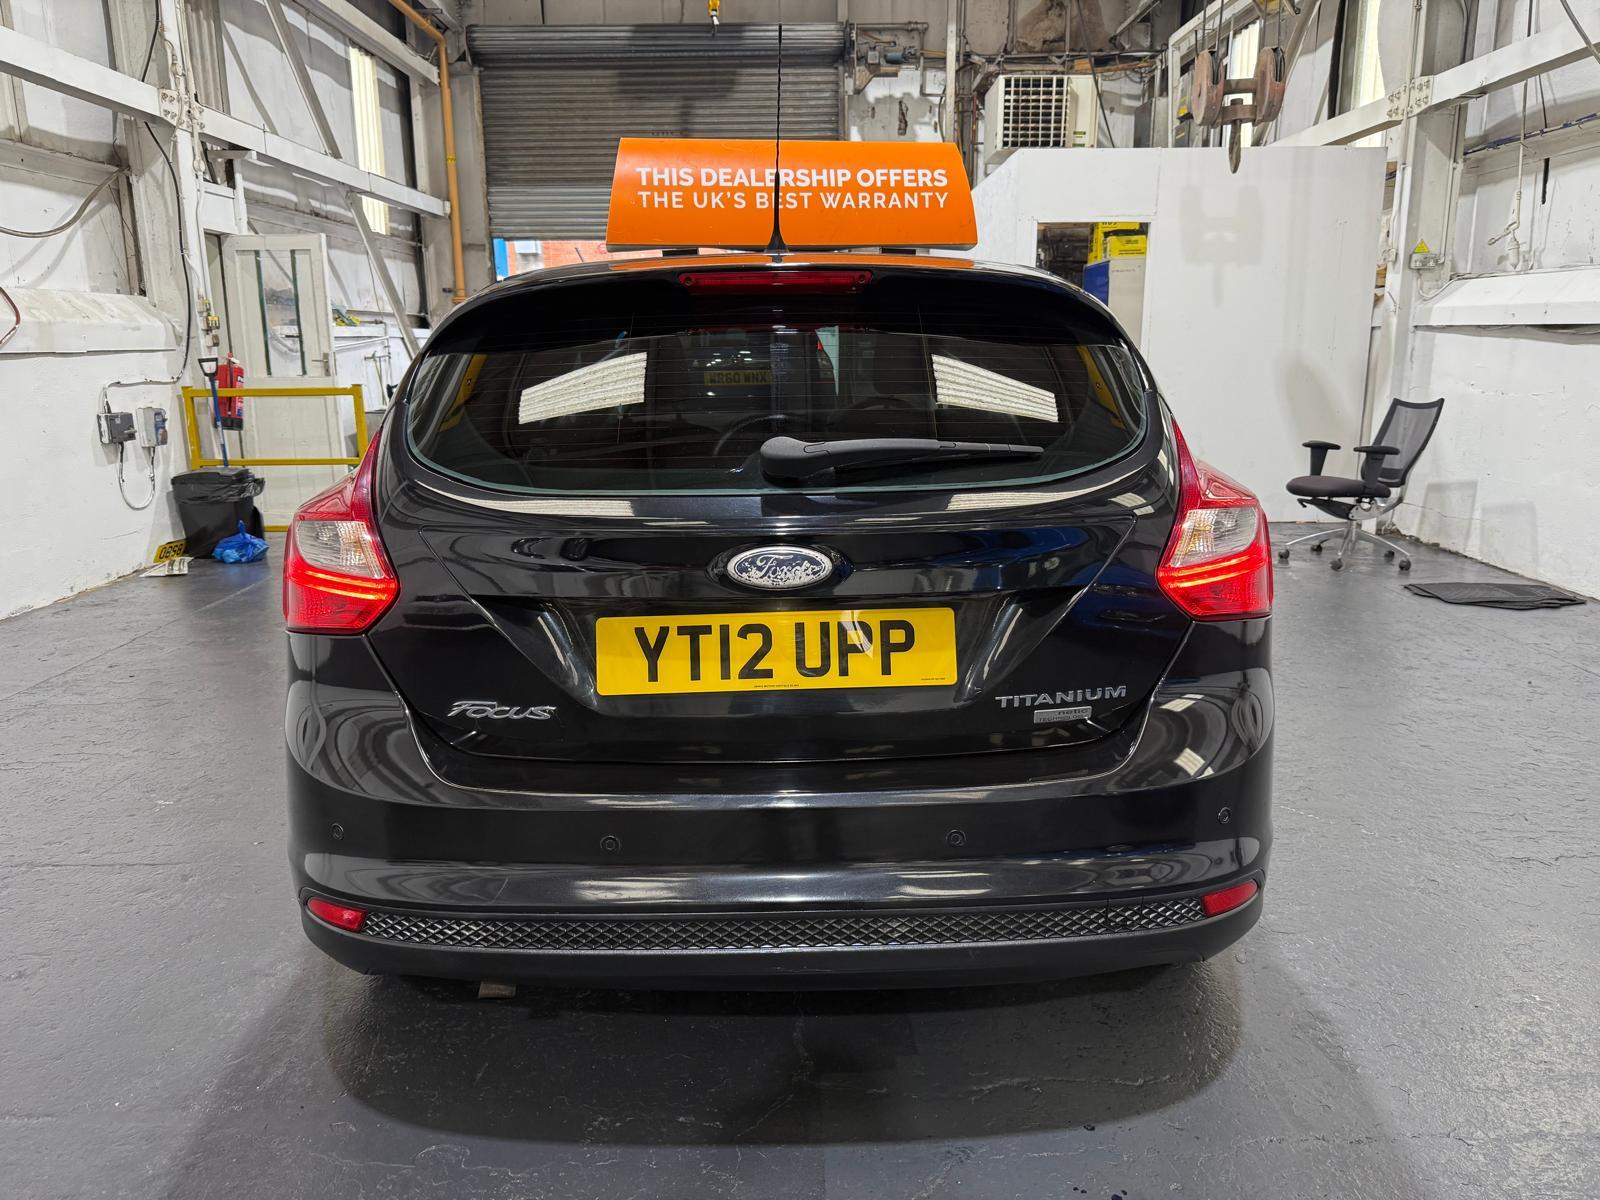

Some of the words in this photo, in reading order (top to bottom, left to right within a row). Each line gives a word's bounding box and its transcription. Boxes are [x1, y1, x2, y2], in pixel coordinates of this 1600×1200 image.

[635, 167, 695, 187] THIS
[701, 167, 851, 187] DEALERSHIP
[856, 168, 948, 188] OFFERS
[637, 191, 684, 208] THE
[693, 191, 746, 208] UK'S
[756, 191, 810, 209] BEST
[820, 191, 949, 209] WARRANTY
[756, 554, 822, 579] Ford
[634, 622, 774, 683] YT12
[795, 619, 916, 678] UPP
[995, 685, 1127, 709] TITANIUM
